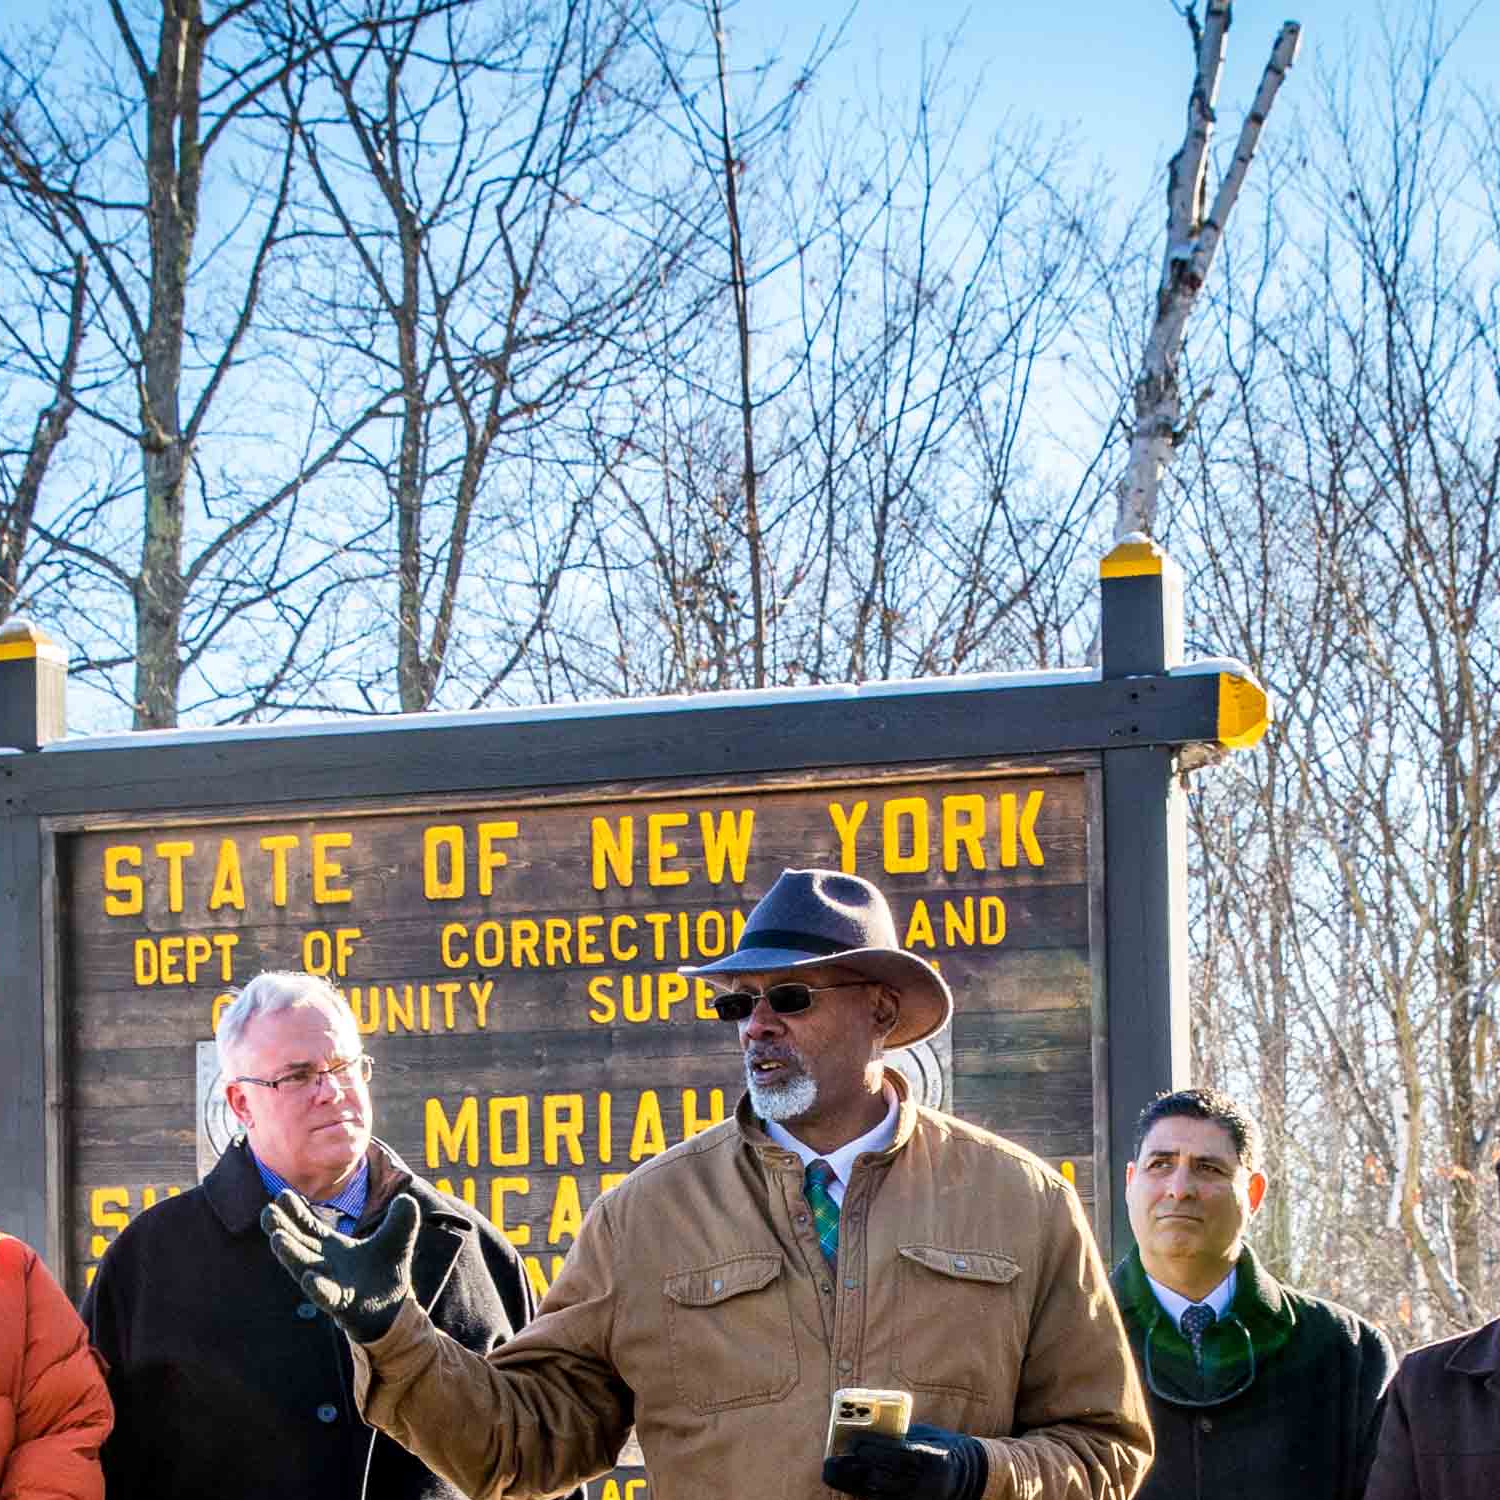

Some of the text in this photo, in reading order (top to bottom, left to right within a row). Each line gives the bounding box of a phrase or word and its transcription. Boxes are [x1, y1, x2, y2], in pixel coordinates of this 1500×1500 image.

[103, 789, 1046, 917] STATE OF NEW YORK
[134, 933, 240, 985] DEPT
[303, 927, 363, 977] OF
[903, 895, 1007, 949] AND
[424, 1087, 725, 1169] MORIAH
